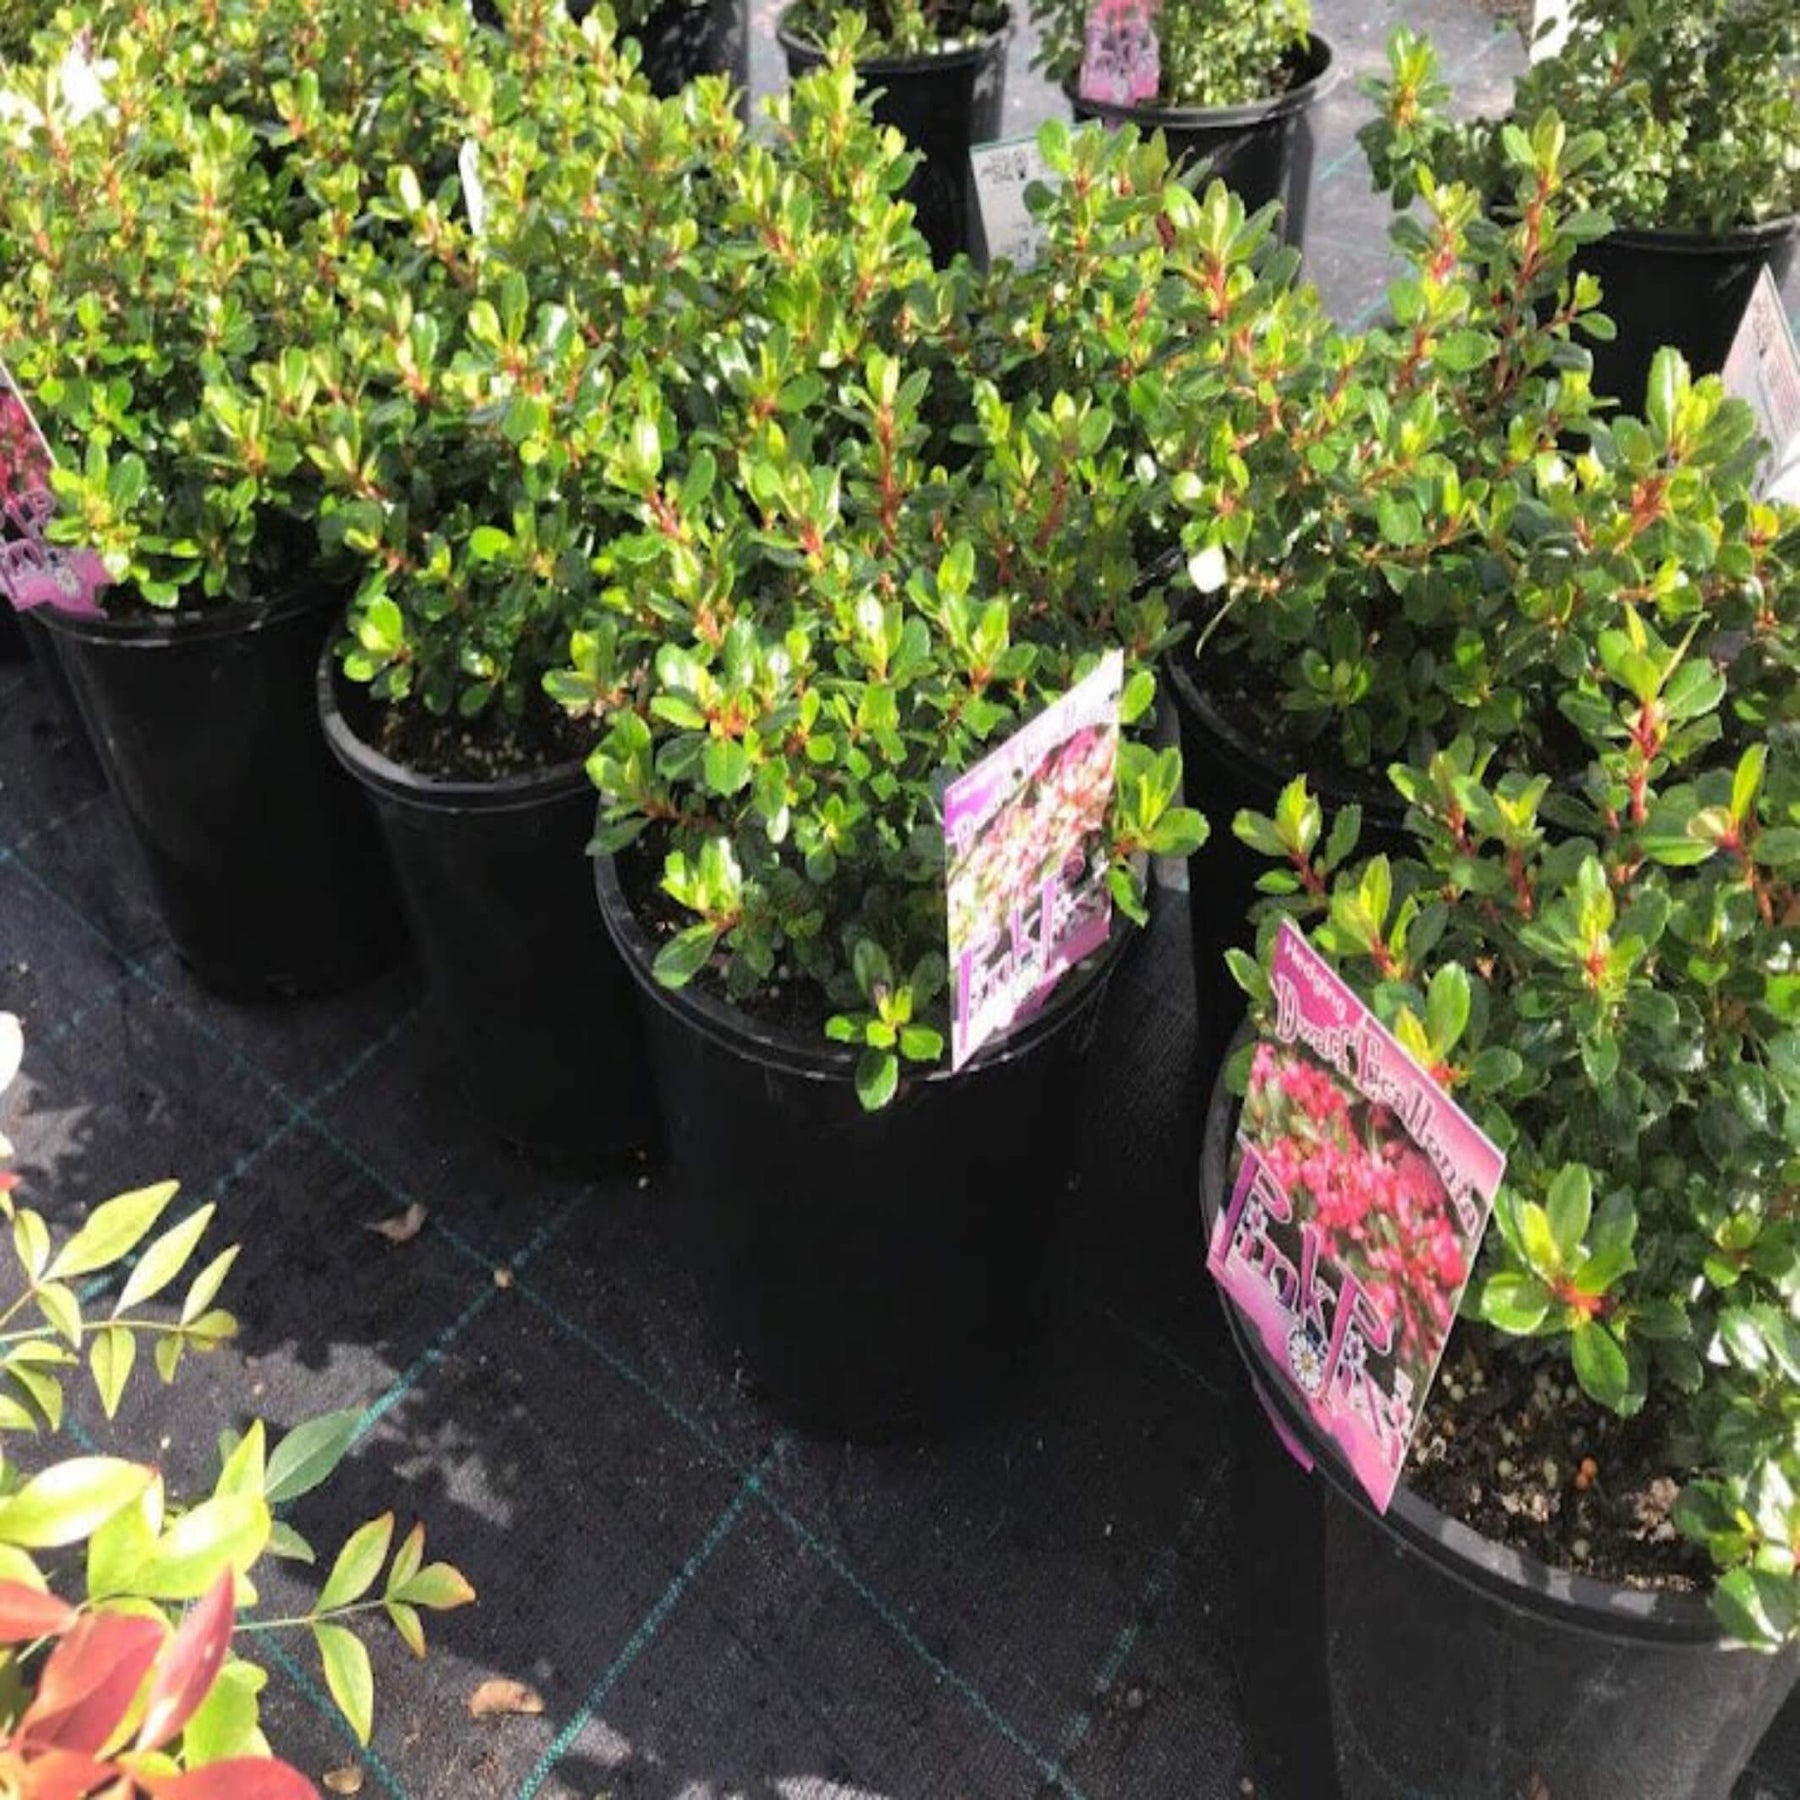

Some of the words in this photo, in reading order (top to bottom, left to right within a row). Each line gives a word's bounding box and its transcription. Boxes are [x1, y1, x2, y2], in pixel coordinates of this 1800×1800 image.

[1283, 933, 1347, 1022] Hedging
[1274, 974, 1355, 1079] Dwarf
[1356, 1018, 1479, 1238] Escallonia
[1208, 1130, 1337, 1350] Pink
